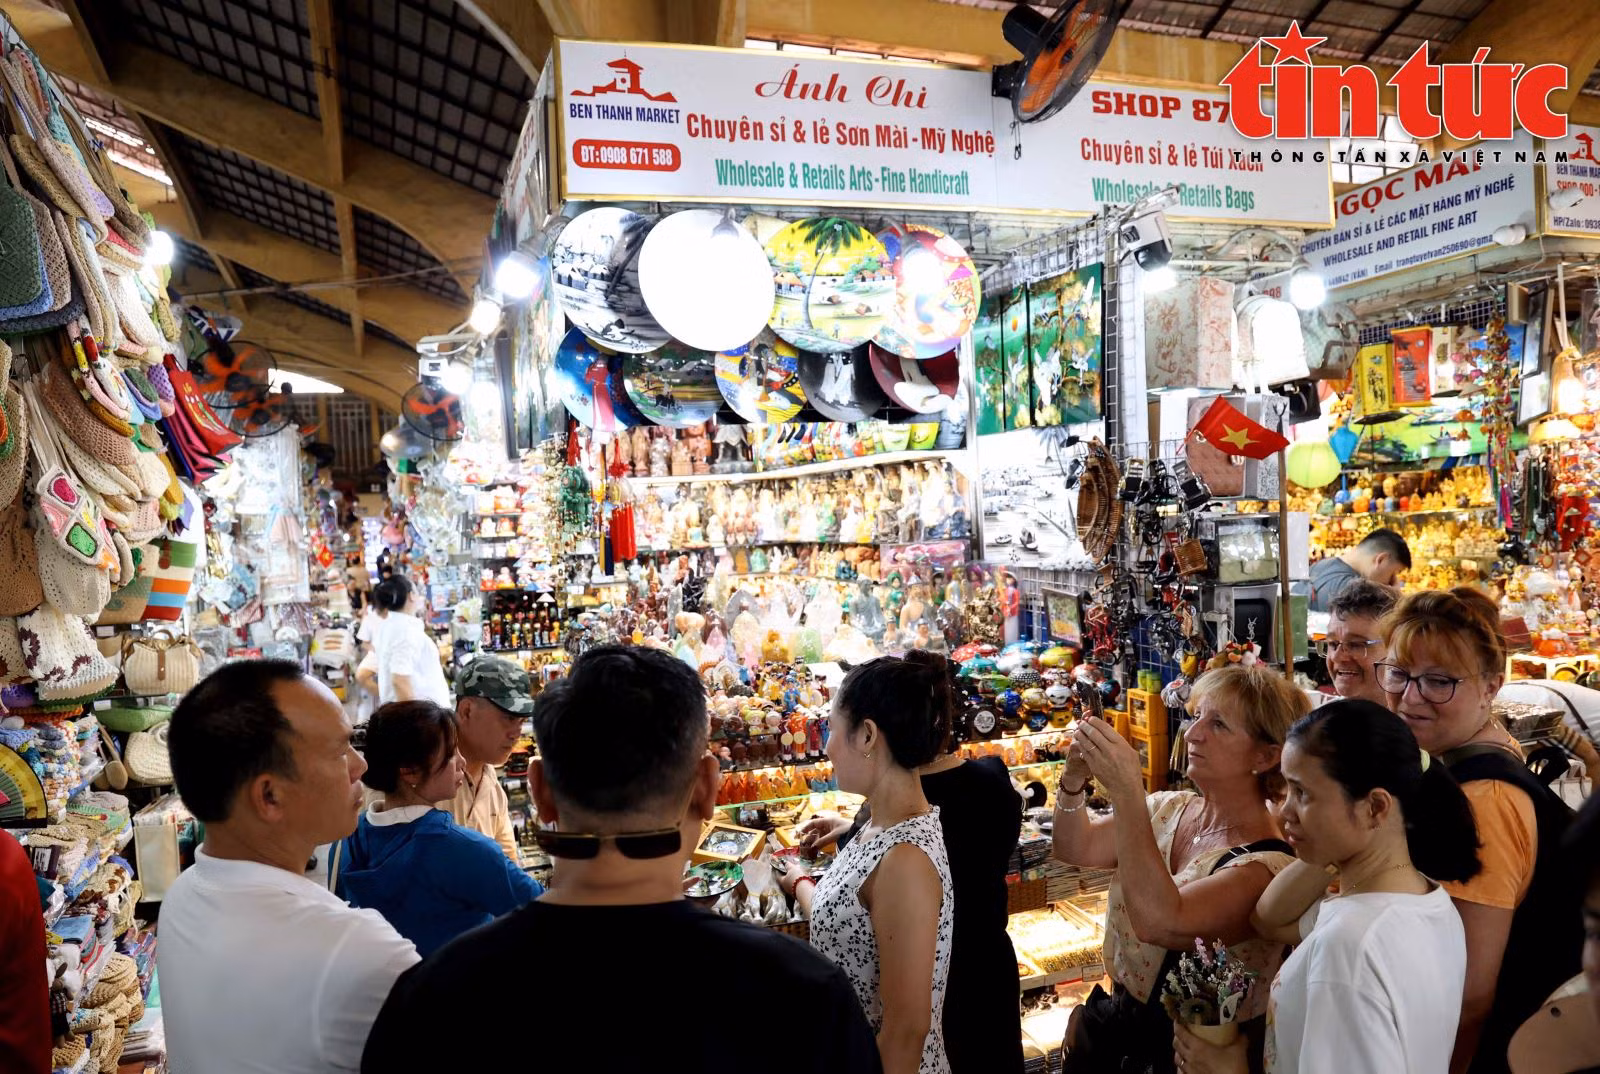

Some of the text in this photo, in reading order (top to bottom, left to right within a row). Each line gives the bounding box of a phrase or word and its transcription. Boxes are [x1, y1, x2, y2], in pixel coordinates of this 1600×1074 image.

[755, 64, 929, 109] Ánh Chi
[570, 103, 680, 124] BEN THANH MARKET
[1092, 90, 1181, 119] SHOP
[687, 113, 764, 143] Chuyên
[770, 116, 786, 142] sỉ
[793, 120, 806, 143] &
[813, 117, 830, 144] lẻ
[836, 122, 870, 147] Sơn
[875, 124, 908, 149] Mài
[921, 127, 946, 153] Mỹ
[951, 129, 995, 158] Nghệ
[1080, 137, 1143, 166] Chuyên
[1149, 140, 1161, 165] sỉ
[1167, 144, 1178, 166] &
[1183, 143, 1197, 167] lẻ
[1201, 145, 1223, 169] Túi
[630, 147, 649, 165] 671
[652, 148, 673, 166] 588
[1570, 164, 1587, 177] THANH
[715, 158, 785, 188] Wholesale
[789, 162, 798, 188] &
[802, 163, 845, 190] Retails
[850, 165, 873, 192] Arts
[881, 166, 906, 193] Fine
[909, 168, 969, 195] Handicraft
[1092, 177, 1255, 212] Wholesal Retails Bags
[1300, 236, 1331, 255] CHUYÊN
[1333, 229, 1351, 245] BÁN
[1365, 223, 1371, 234] &
[1387, 211, 1406, 228] CÁC
[1409, 203, 1430, 220] MẶT
[1433, 195, 1462, 213] HÀNG
[1464, 185, 1481, 203] MỸ
[1484, 173, 1515, 196] NGHỆ
[1323, 210, 1477, 267] WHOLESALE AND RETAIL FINE ART
